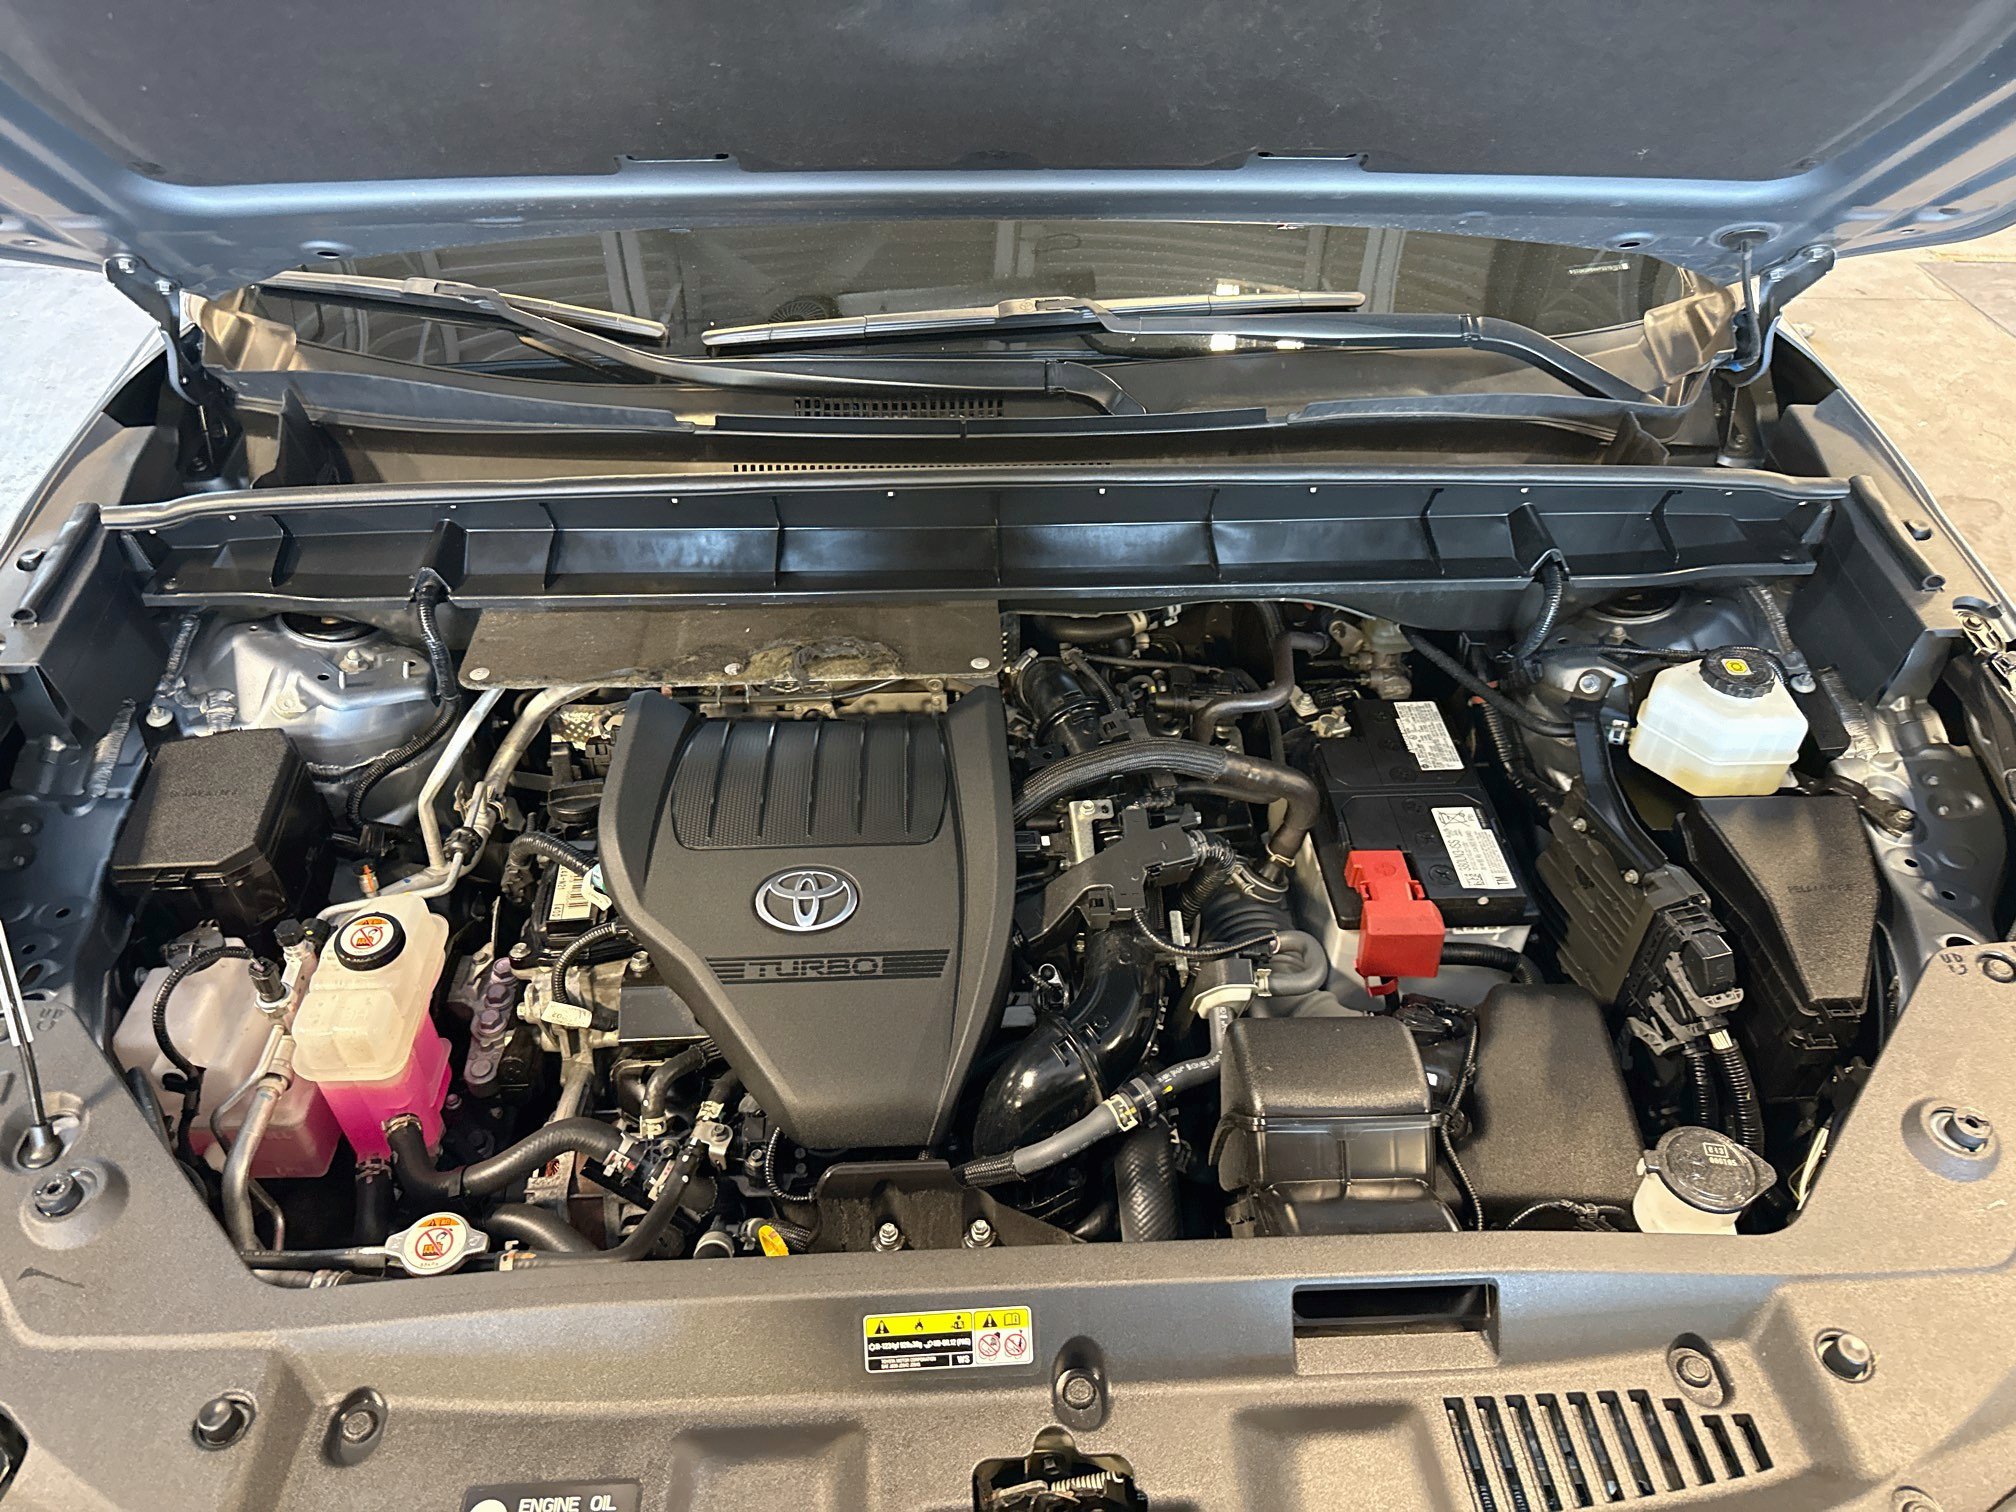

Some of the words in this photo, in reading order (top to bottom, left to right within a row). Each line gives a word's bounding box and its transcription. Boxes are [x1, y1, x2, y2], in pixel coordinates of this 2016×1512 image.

[749, 957, 878, 978] TURBO
[518, 1496, 581, 1512] ENGINE
[590, 1494, 617, 1511] OIL
